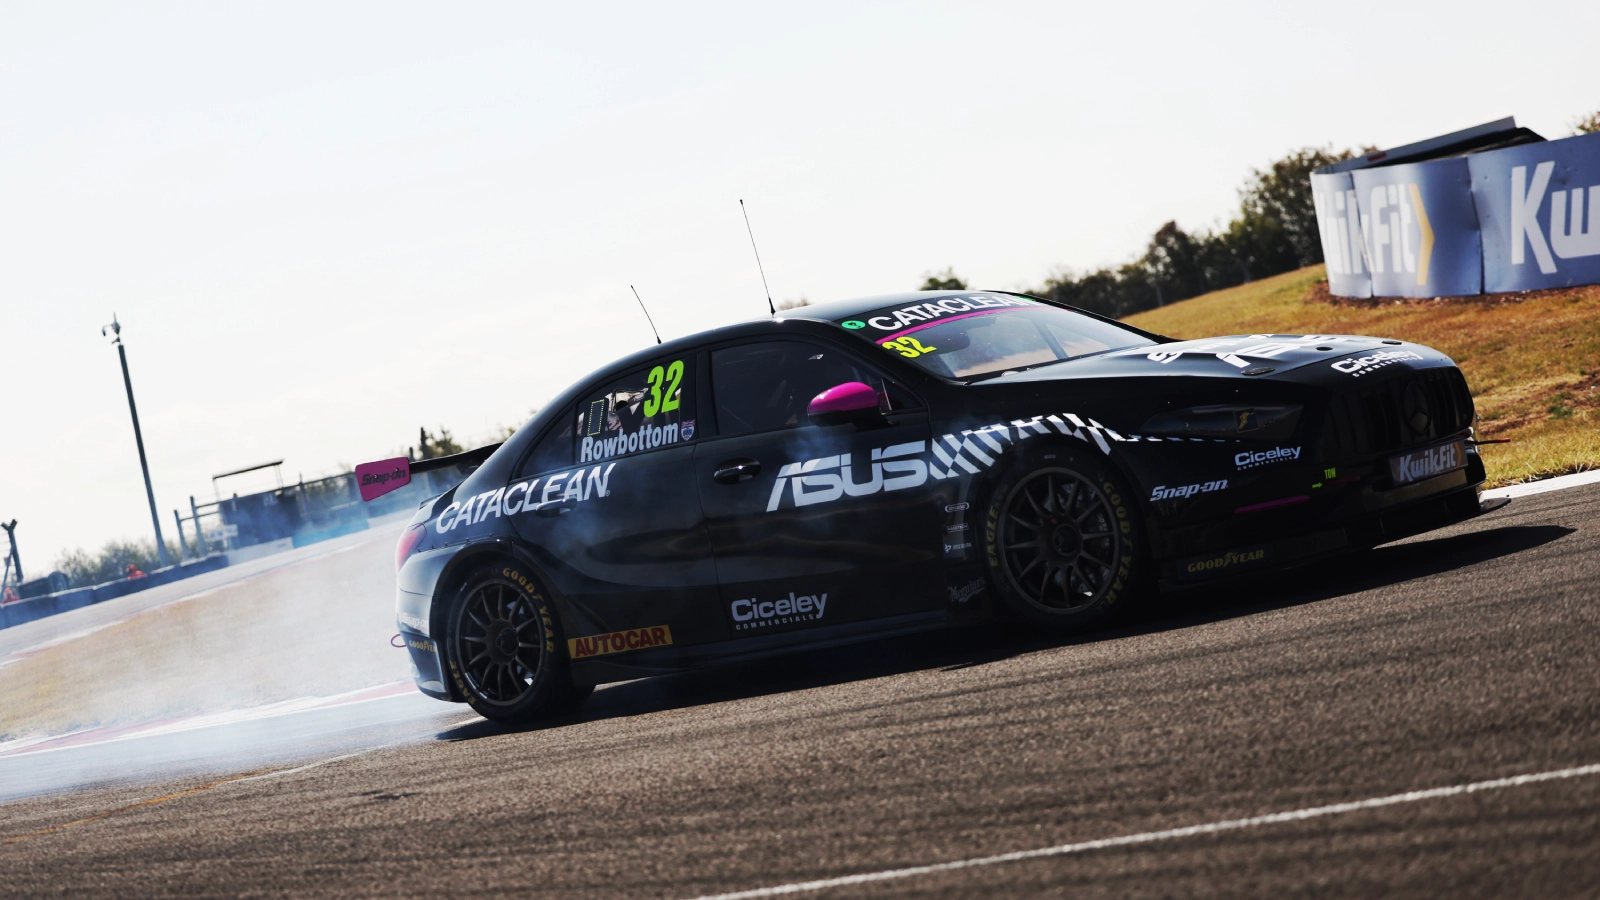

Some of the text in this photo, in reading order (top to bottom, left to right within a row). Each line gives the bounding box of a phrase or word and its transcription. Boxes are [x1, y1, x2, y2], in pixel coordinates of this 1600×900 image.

[881, 335, 938, 359] 32
[1331, 351, 1424, 374] Ciceley
[643, 359, 685, 418] 32
[580, 422, 679, 462] Rowbottom
[1234, 445, 1302, 466] Ciceley
[766, 440, 929, 513] ASUS
[1324, 467, 1336, 479] TOW
[1399, 442, 1457, 482] KwikFit
[361, 469, 407, 487] Snap-on
[1149, 479, 1229, 502] Snap-on
[435, 462, 617, 534] CATACLEAN
[986, 505, 999, 568] EAGLE
[1103, 481, 1133, 606] GOODYEAR
[1187, 549, 1265, 573] GOODYEAR
[502, 567, 555, 653] GOODYEAR
[731, 591, 828, 622] Ciceley
[735, 614, 814, 631] COMMERCIALS
[409, 639, 437, 653] GOODYEA
[574, 626, 667, 658] AUTOCAR
[449, 660, 477, 705] EAGLE
